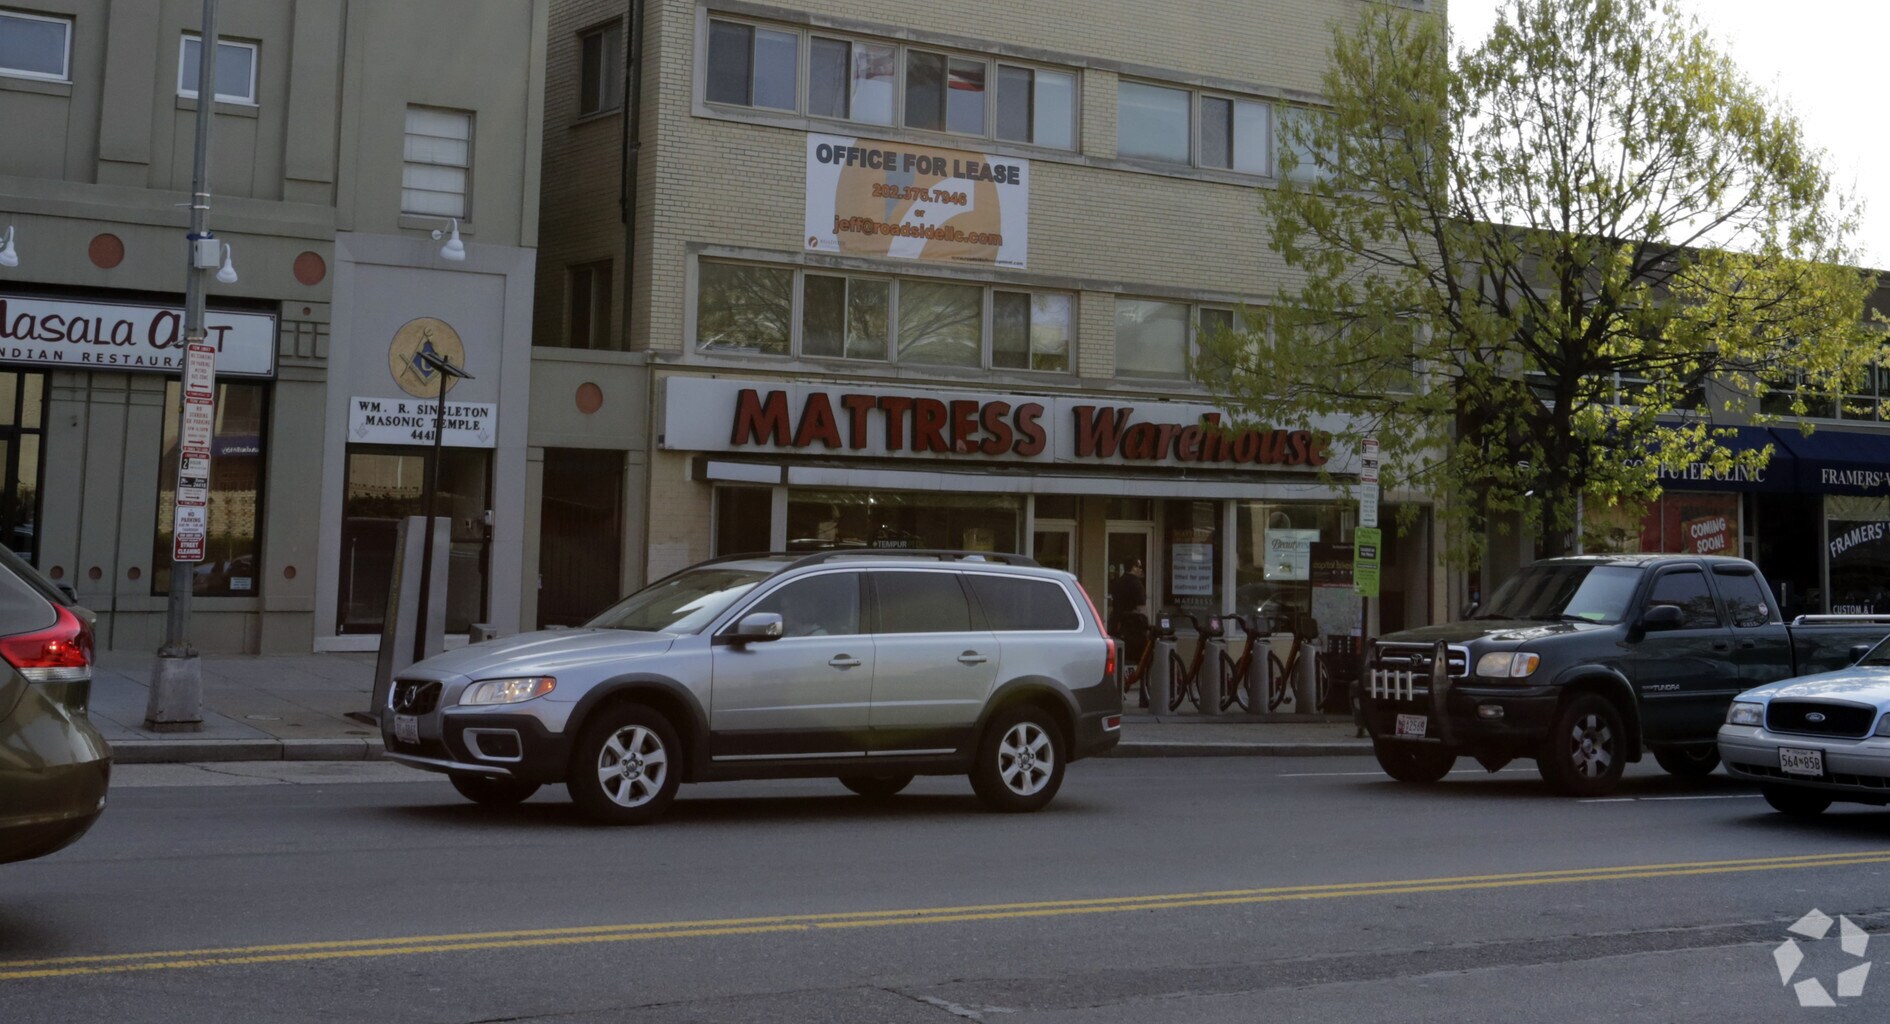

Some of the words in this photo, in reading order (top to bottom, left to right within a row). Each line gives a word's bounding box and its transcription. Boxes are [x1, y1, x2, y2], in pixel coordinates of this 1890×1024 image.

[816, 143, 897, 172] OFFICE
[903, 153, 948, 177] FOR
[953, 159, 1021, 185] LEASE
[914, 208, 925, 218] or
[832, 214, 1004, 246] jeff@roadsidellc.com
[82, 351, 185, 367] RESTAURA
[358, 401, 387, 413] WM.
[398, 403, 410, 414] R.
[365, 415, 424, 428] MASONIC
[431, 418, 480, 431] TEMPLE
[730, 388, 1048, 458] MATTRESS
[1072, 405, 1333, 467] Warehouse
[410, 429, 435, 441] 4441
[1690, 517, 1726, 539] COMING
[1697, 534, 1725, 554] SOON!
[1832, 604, 1862, 614] CUSTOM
